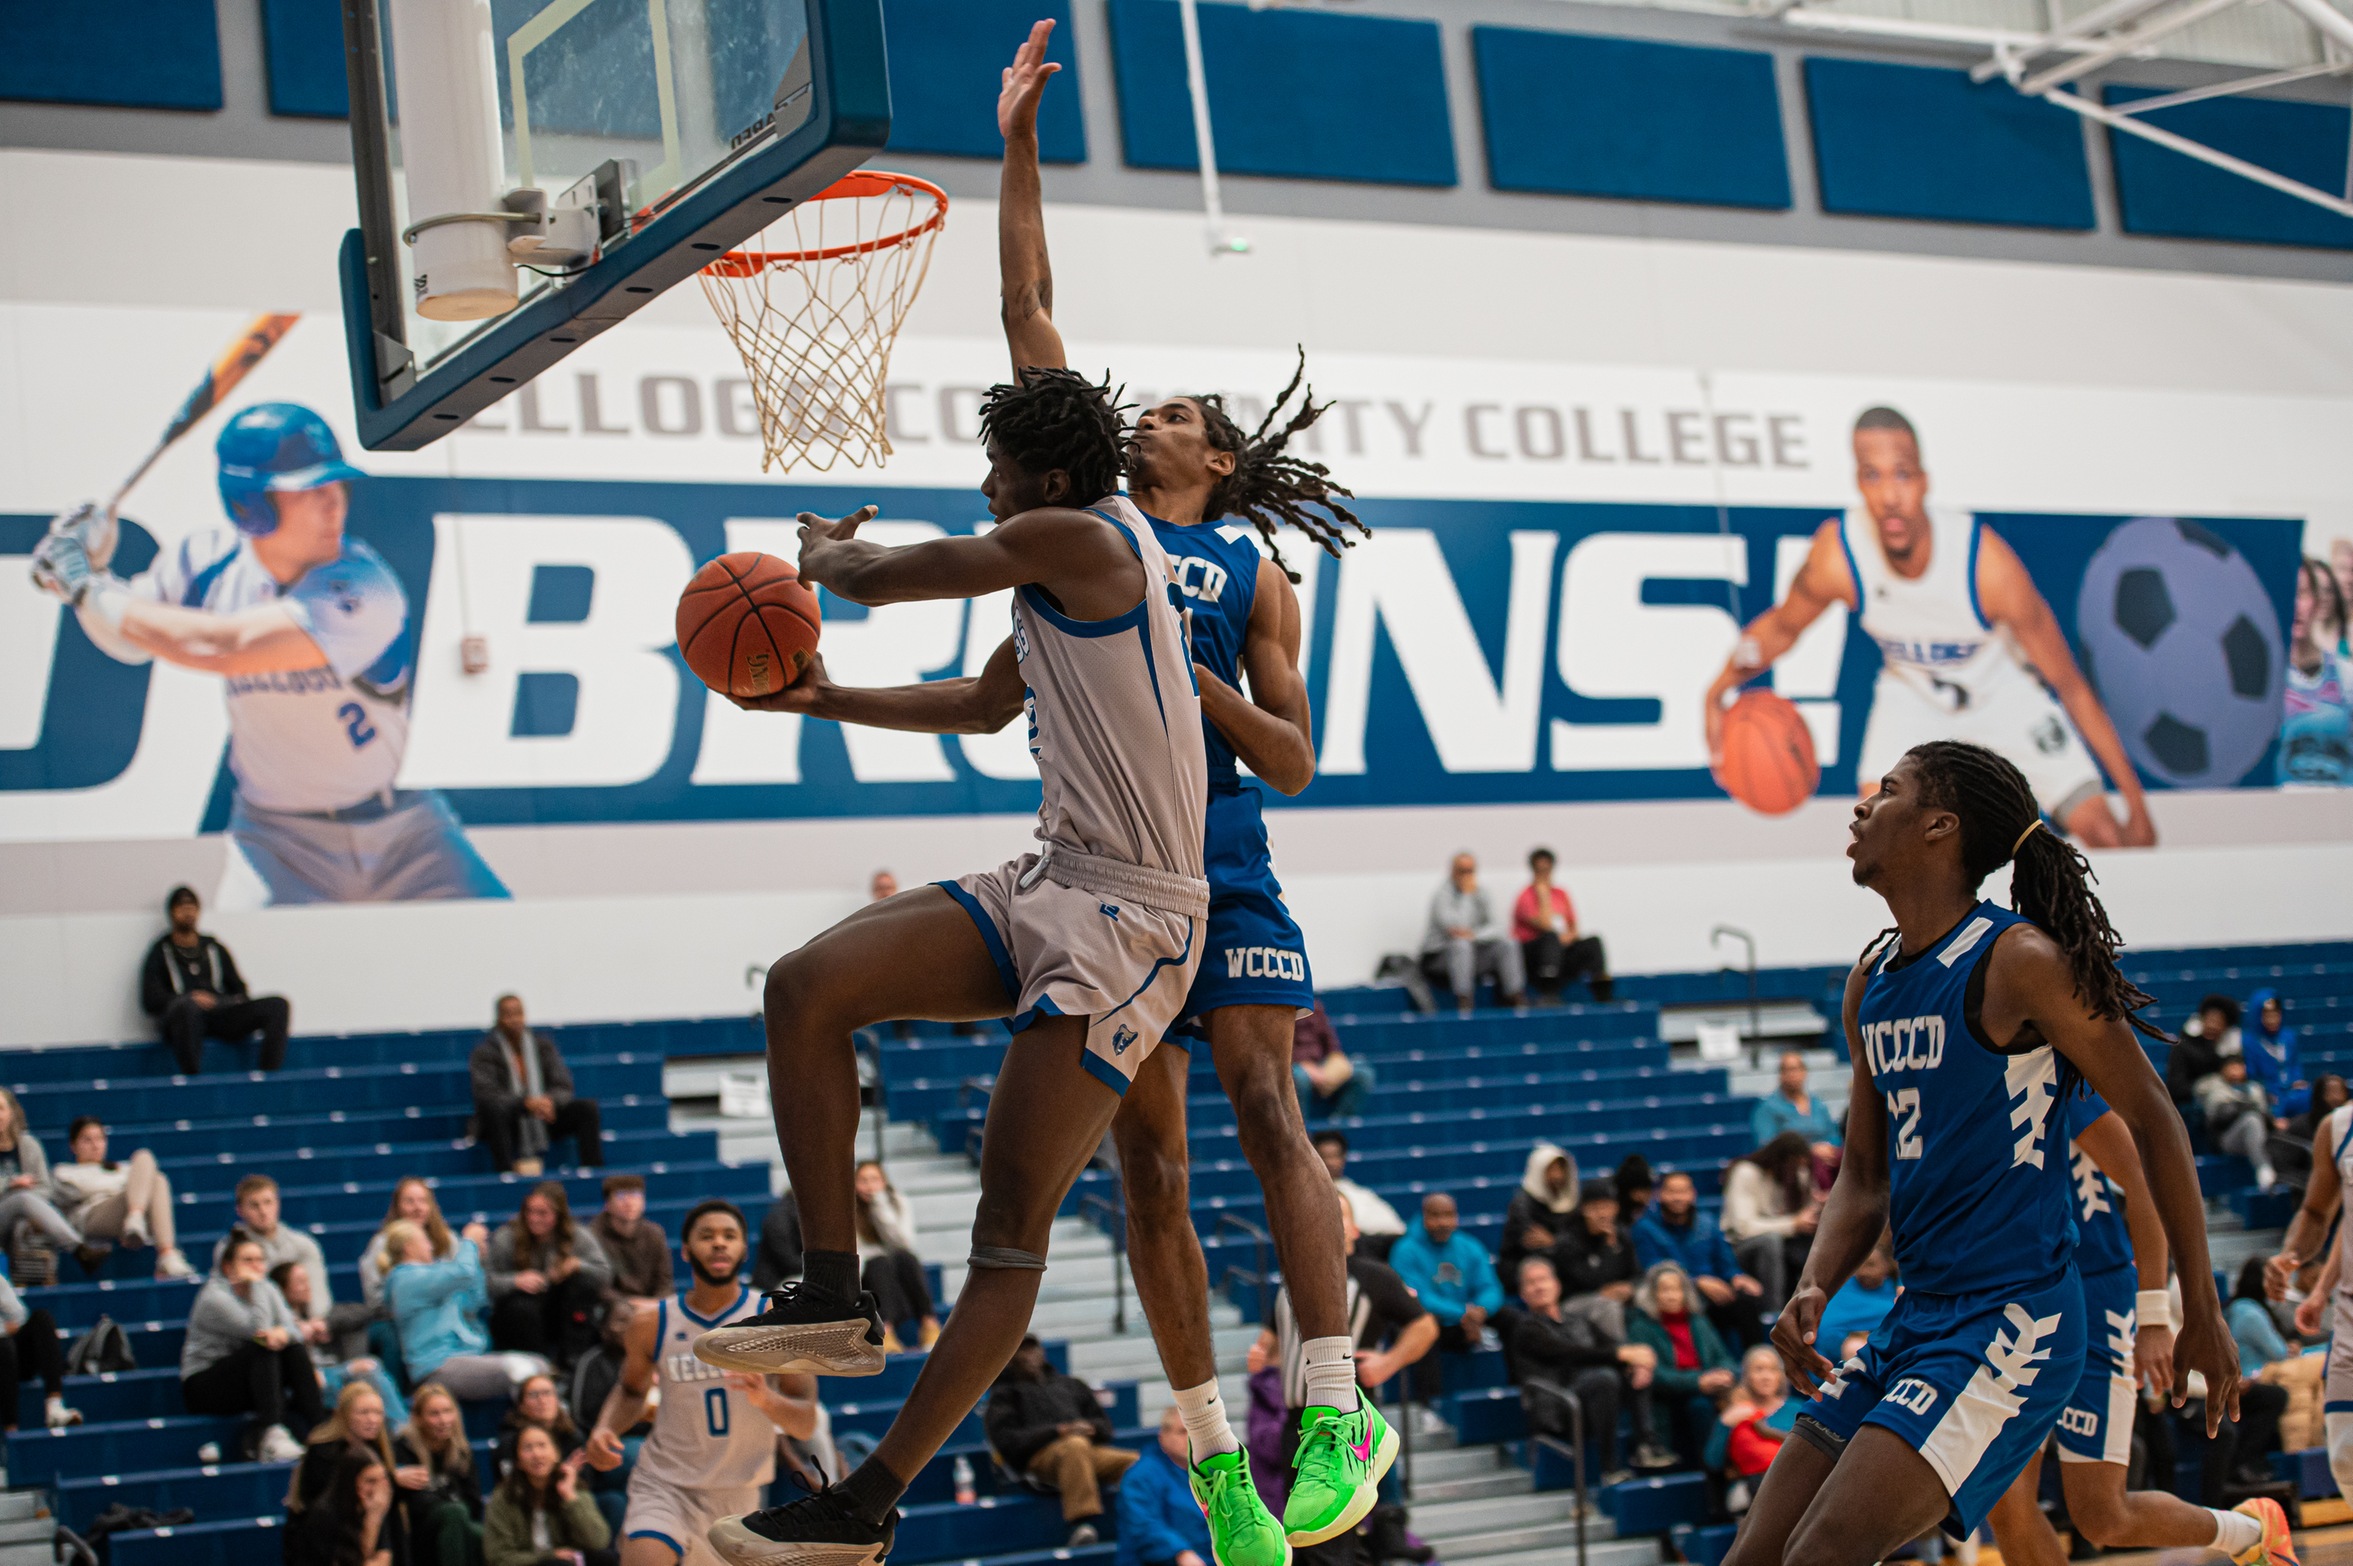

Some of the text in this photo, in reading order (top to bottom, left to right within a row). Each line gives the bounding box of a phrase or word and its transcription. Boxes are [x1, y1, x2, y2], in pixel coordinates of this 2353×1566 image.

[457, 373, 846, 444] LLOGG
[1465, 404, 1808, 468] COLLEGE
[395, 513, 1852, 788] BRNS!
[338, 702, 376, 747] 2
[1225, 946, 1305, 982] WCCCD
[704, 1386, 730, 1438] 0
